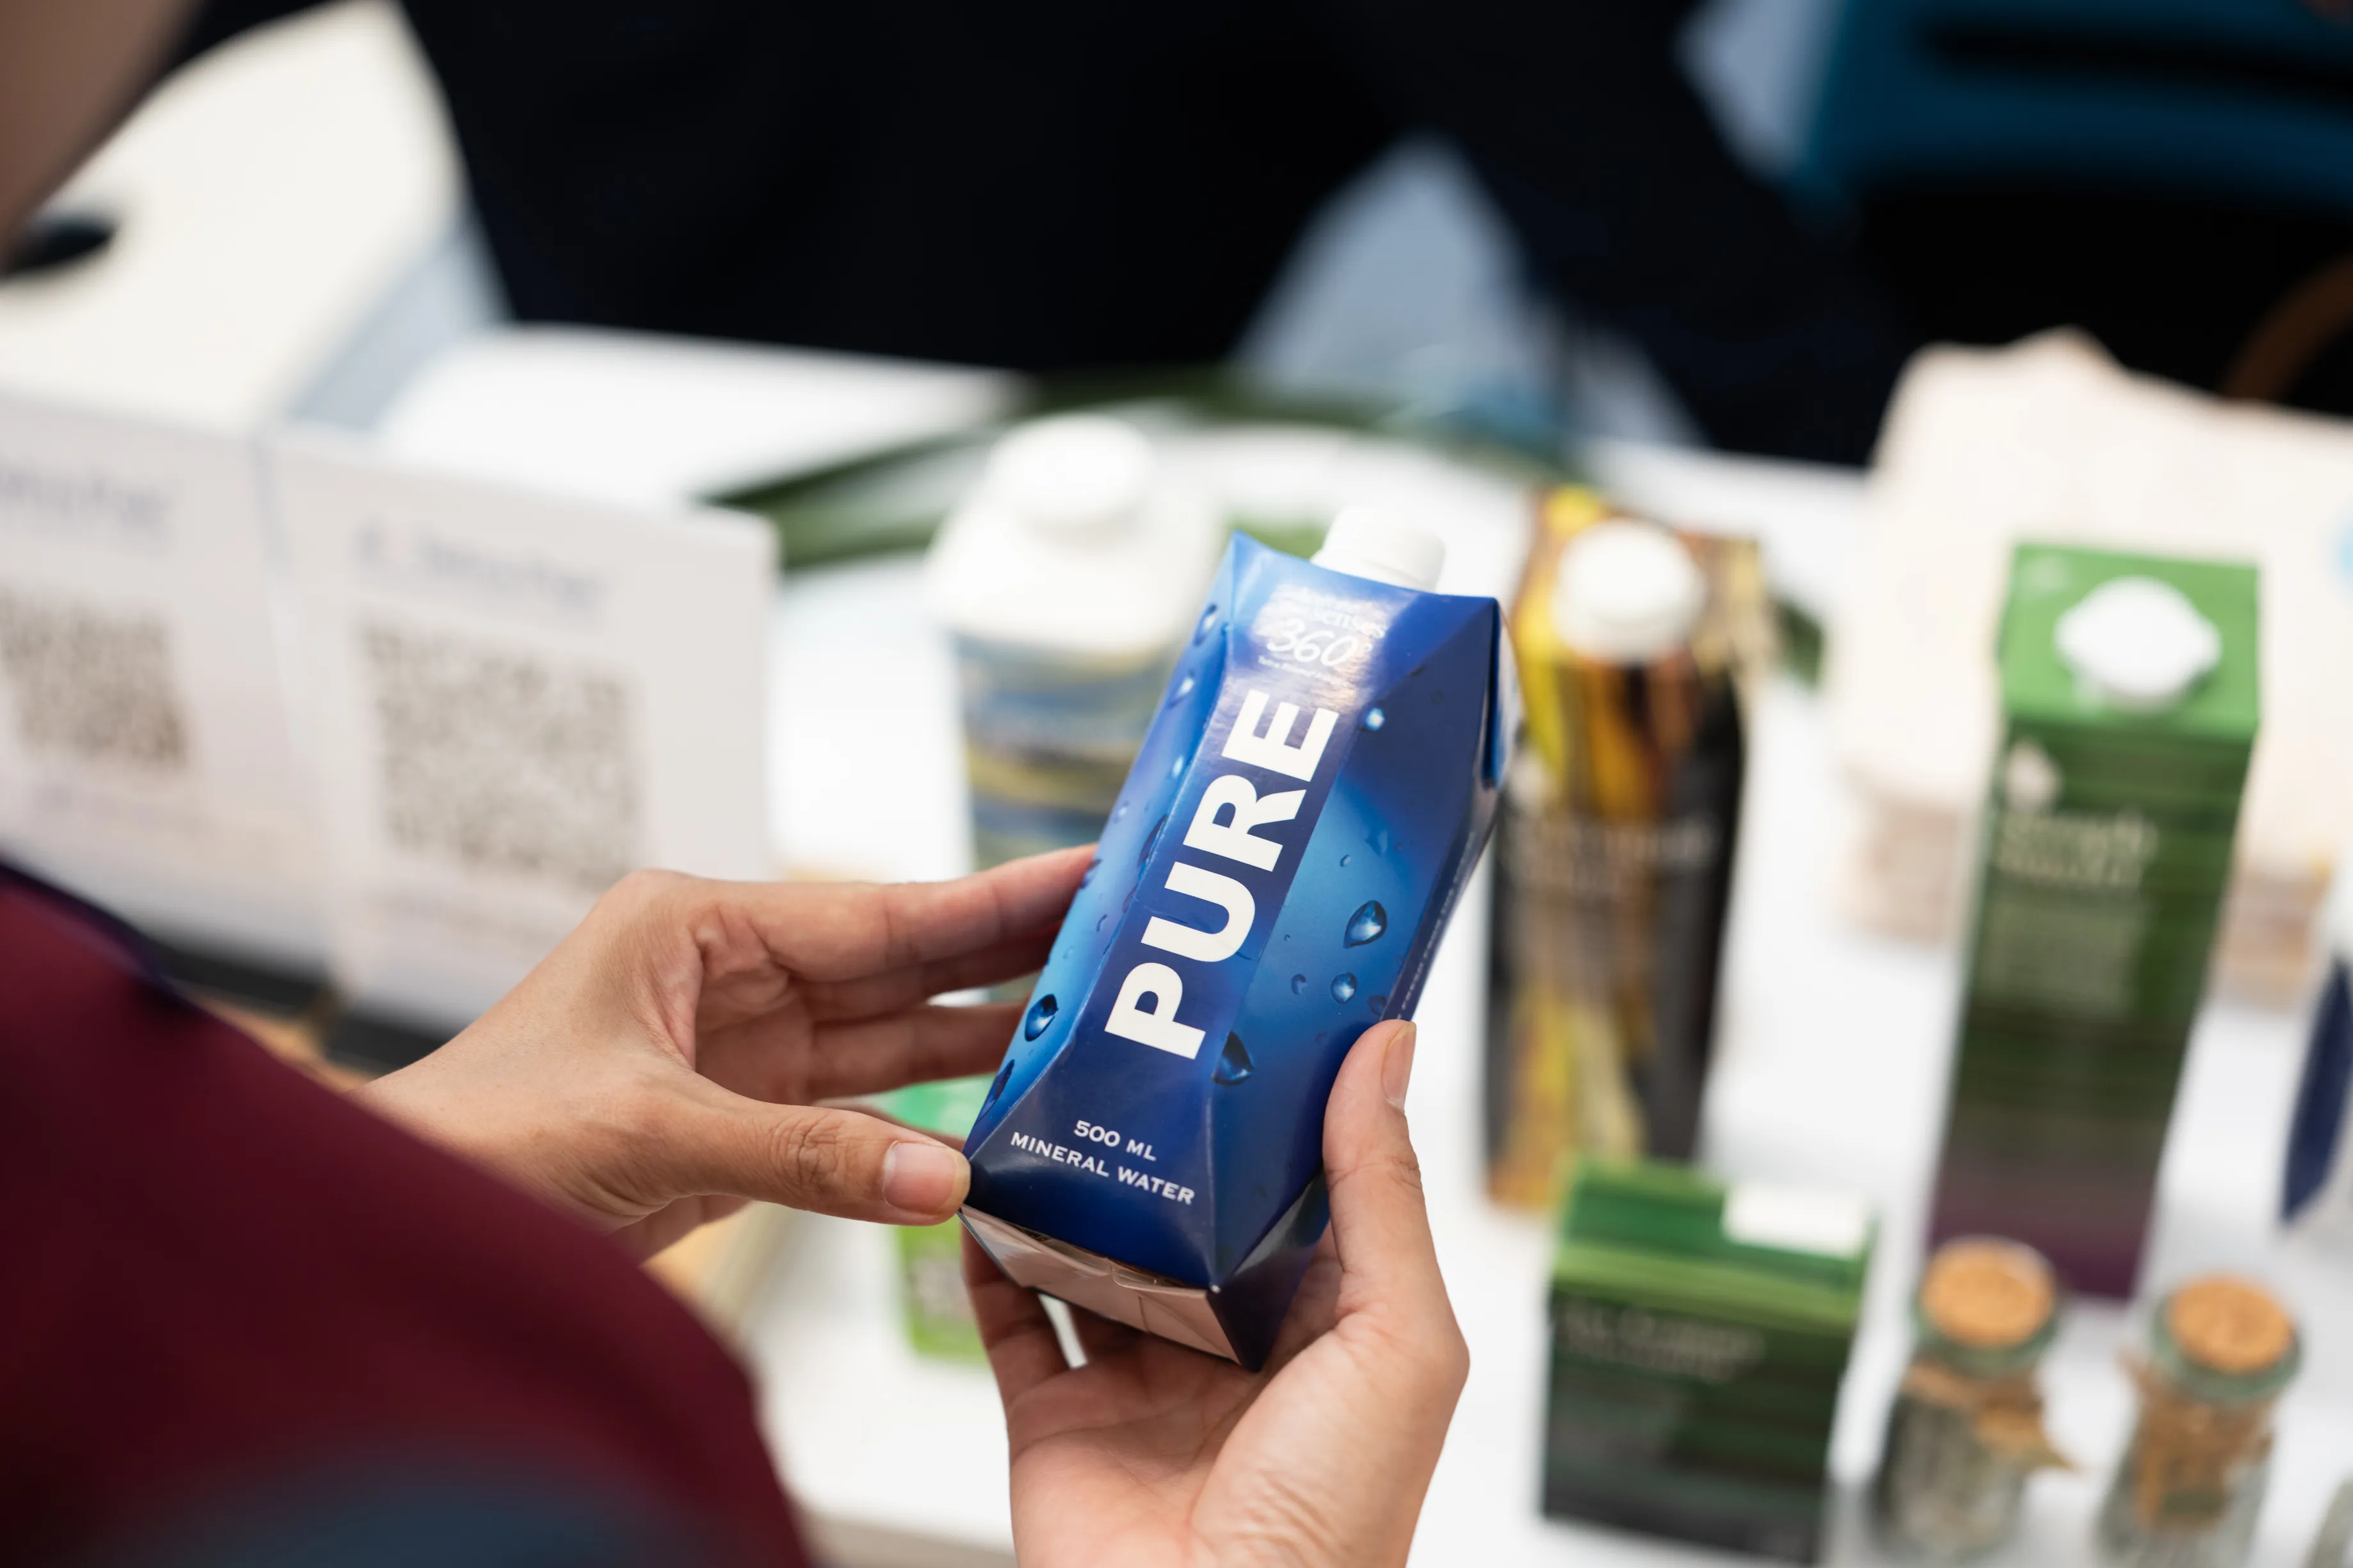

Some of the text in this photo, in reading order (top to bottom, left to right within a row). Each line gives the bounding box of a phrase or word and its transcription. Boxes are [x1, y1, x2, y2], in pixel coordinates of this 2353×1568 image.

[1104, 689, 1340, 1060] PURE
[1010, 1131, 1196, 1205] MINERAL WATER
[1073, 1120, 1157, 1162] 500 ML
